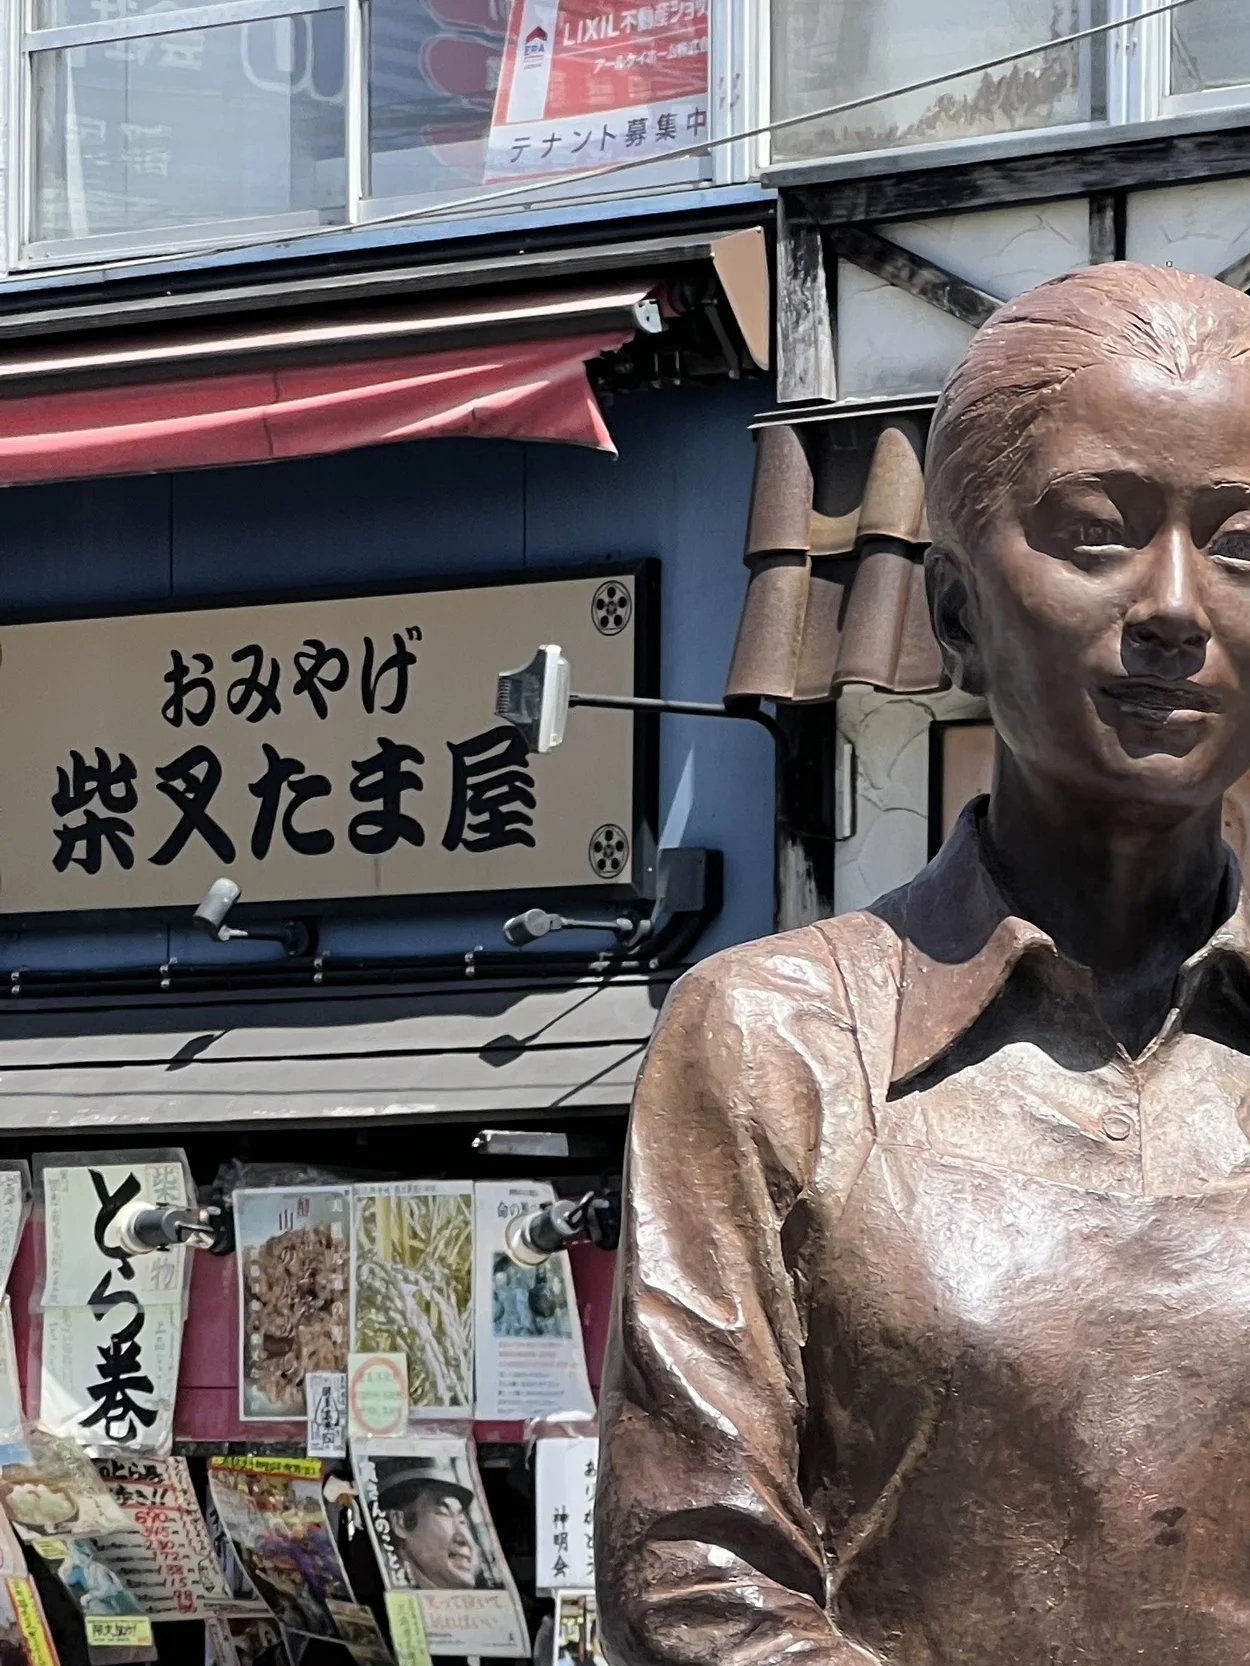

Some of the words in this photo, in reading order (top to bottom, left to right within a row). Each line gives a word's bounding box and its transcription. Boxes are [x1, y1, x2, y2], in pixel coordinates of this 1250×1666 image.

[523, 43, 545, 56] ERA
[510, 107, 707, 163] テナント募集中
[161, 625, 422, 728] おみやげ
[78, 1168, 158, 1442] とら巻
[552, 1504, 570, 1578] 神明会
